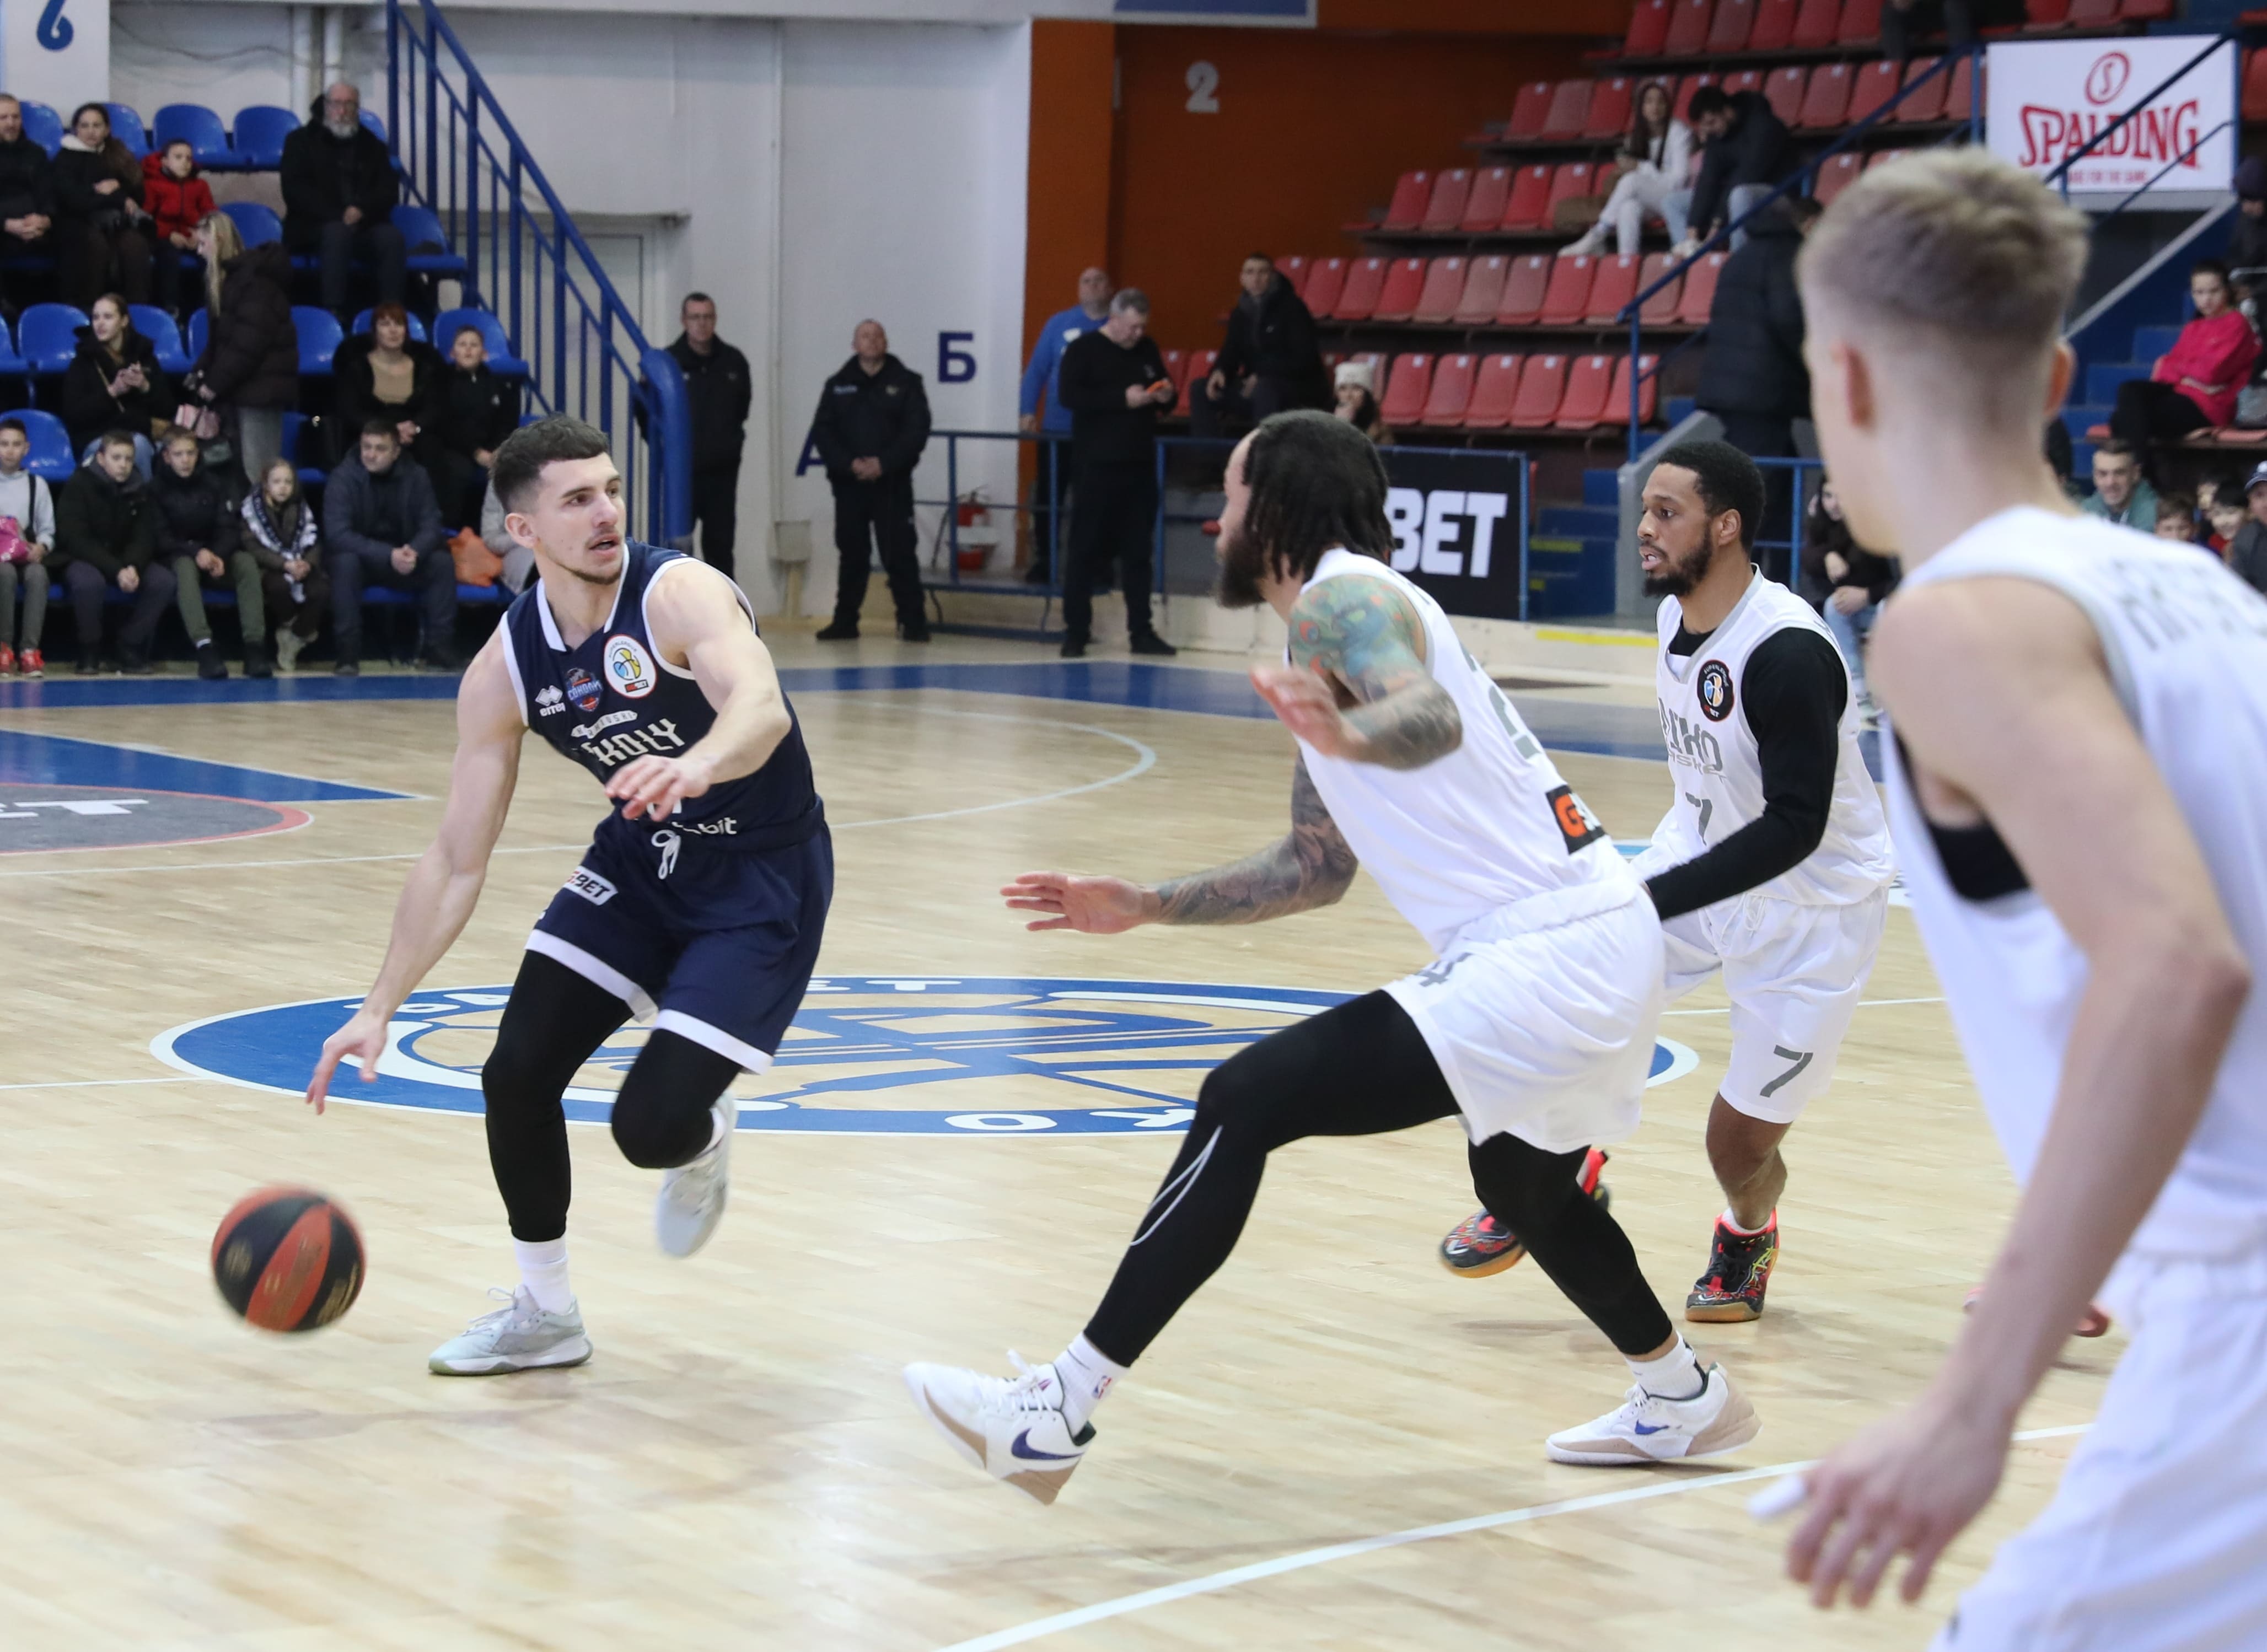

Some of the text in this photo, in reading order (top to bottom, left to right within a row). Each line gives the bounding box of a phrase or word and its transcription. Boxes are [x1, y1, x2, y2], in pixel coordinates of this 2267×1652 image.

[36, 0, 74, 51] 6
[1186, 61, 1220, 113] 2
[2019, 99, 2200, 169] SPALDING
[938, 332, 976, 382] Б
[1759, 1045, 1813, 1097] 7
